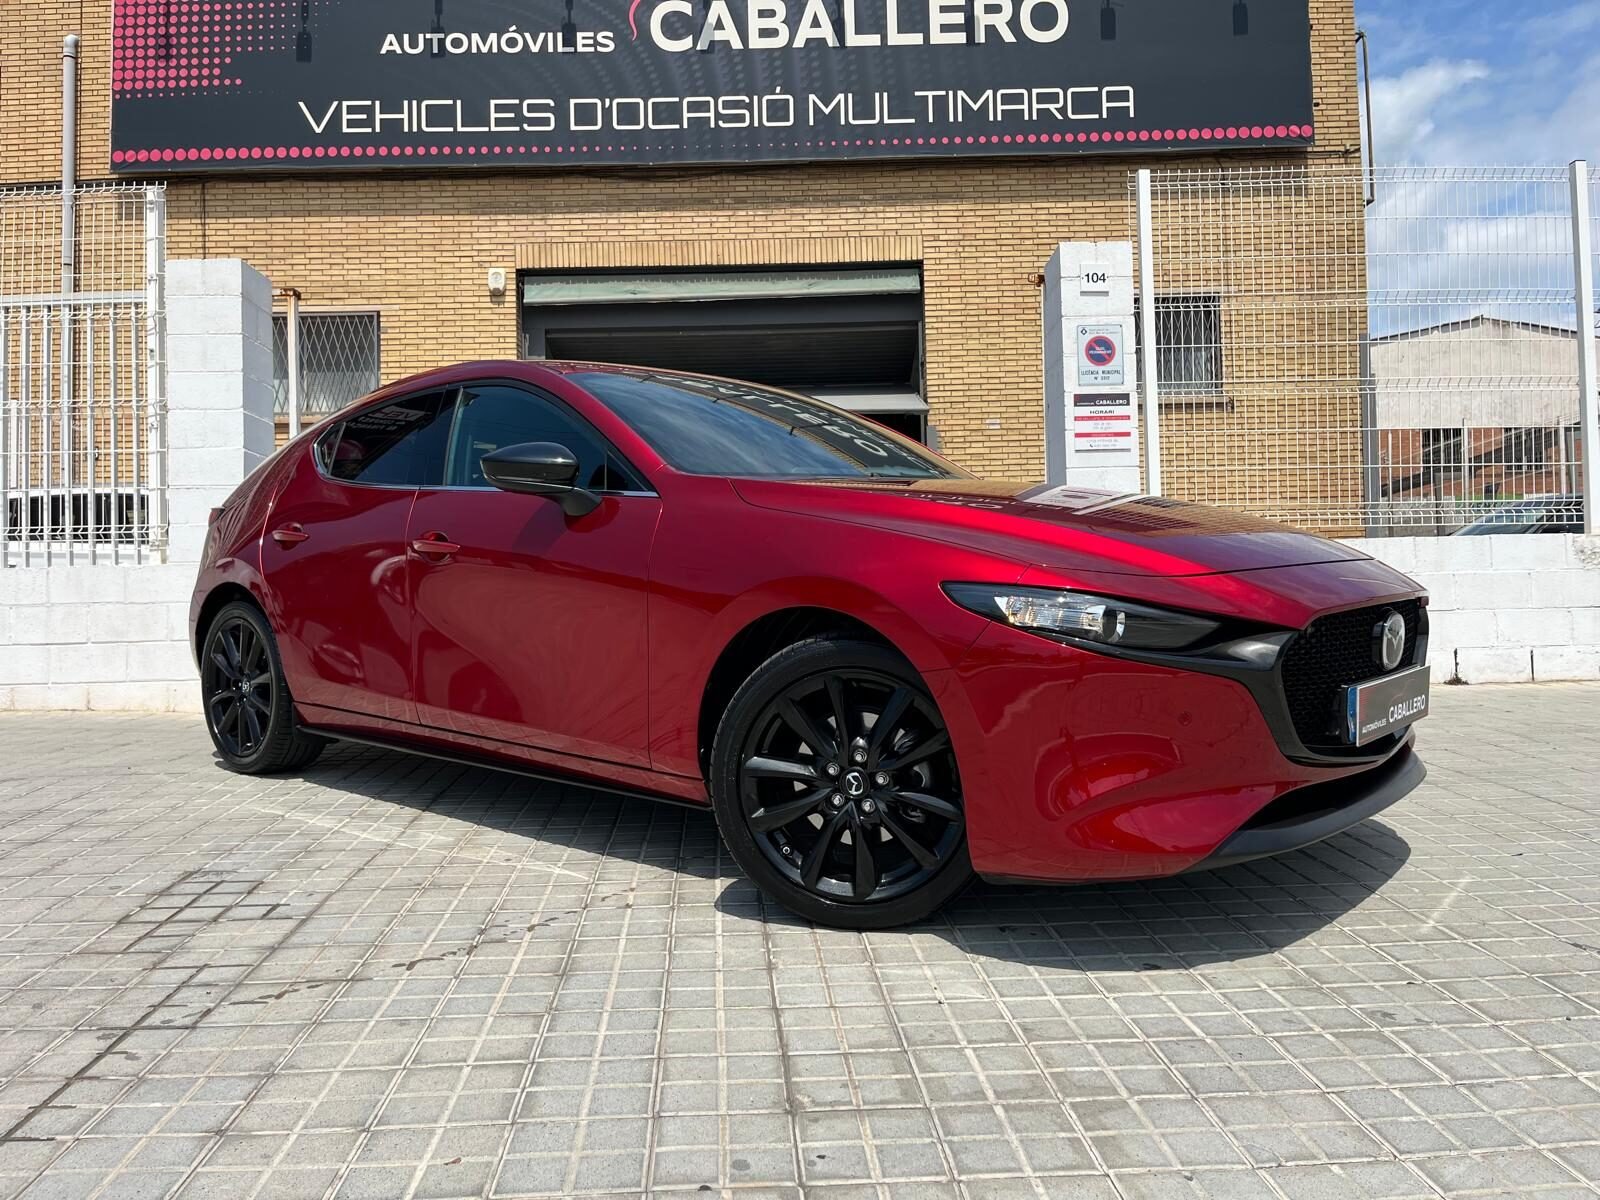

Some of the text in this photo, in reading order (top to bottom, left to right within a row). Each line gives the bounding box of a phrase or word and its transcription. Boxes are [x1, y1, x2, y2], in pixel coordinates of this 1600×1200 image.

[379, 0, 1070, 54] AUTOMÓVILES CABALLERO
[298, 86, 1135, 134] VEHICLES D'OCASIÓ MULTIMARCA
[1084, 272, 1107, 283] 104
[1389, 694, 1425, 723] CABALLERO
